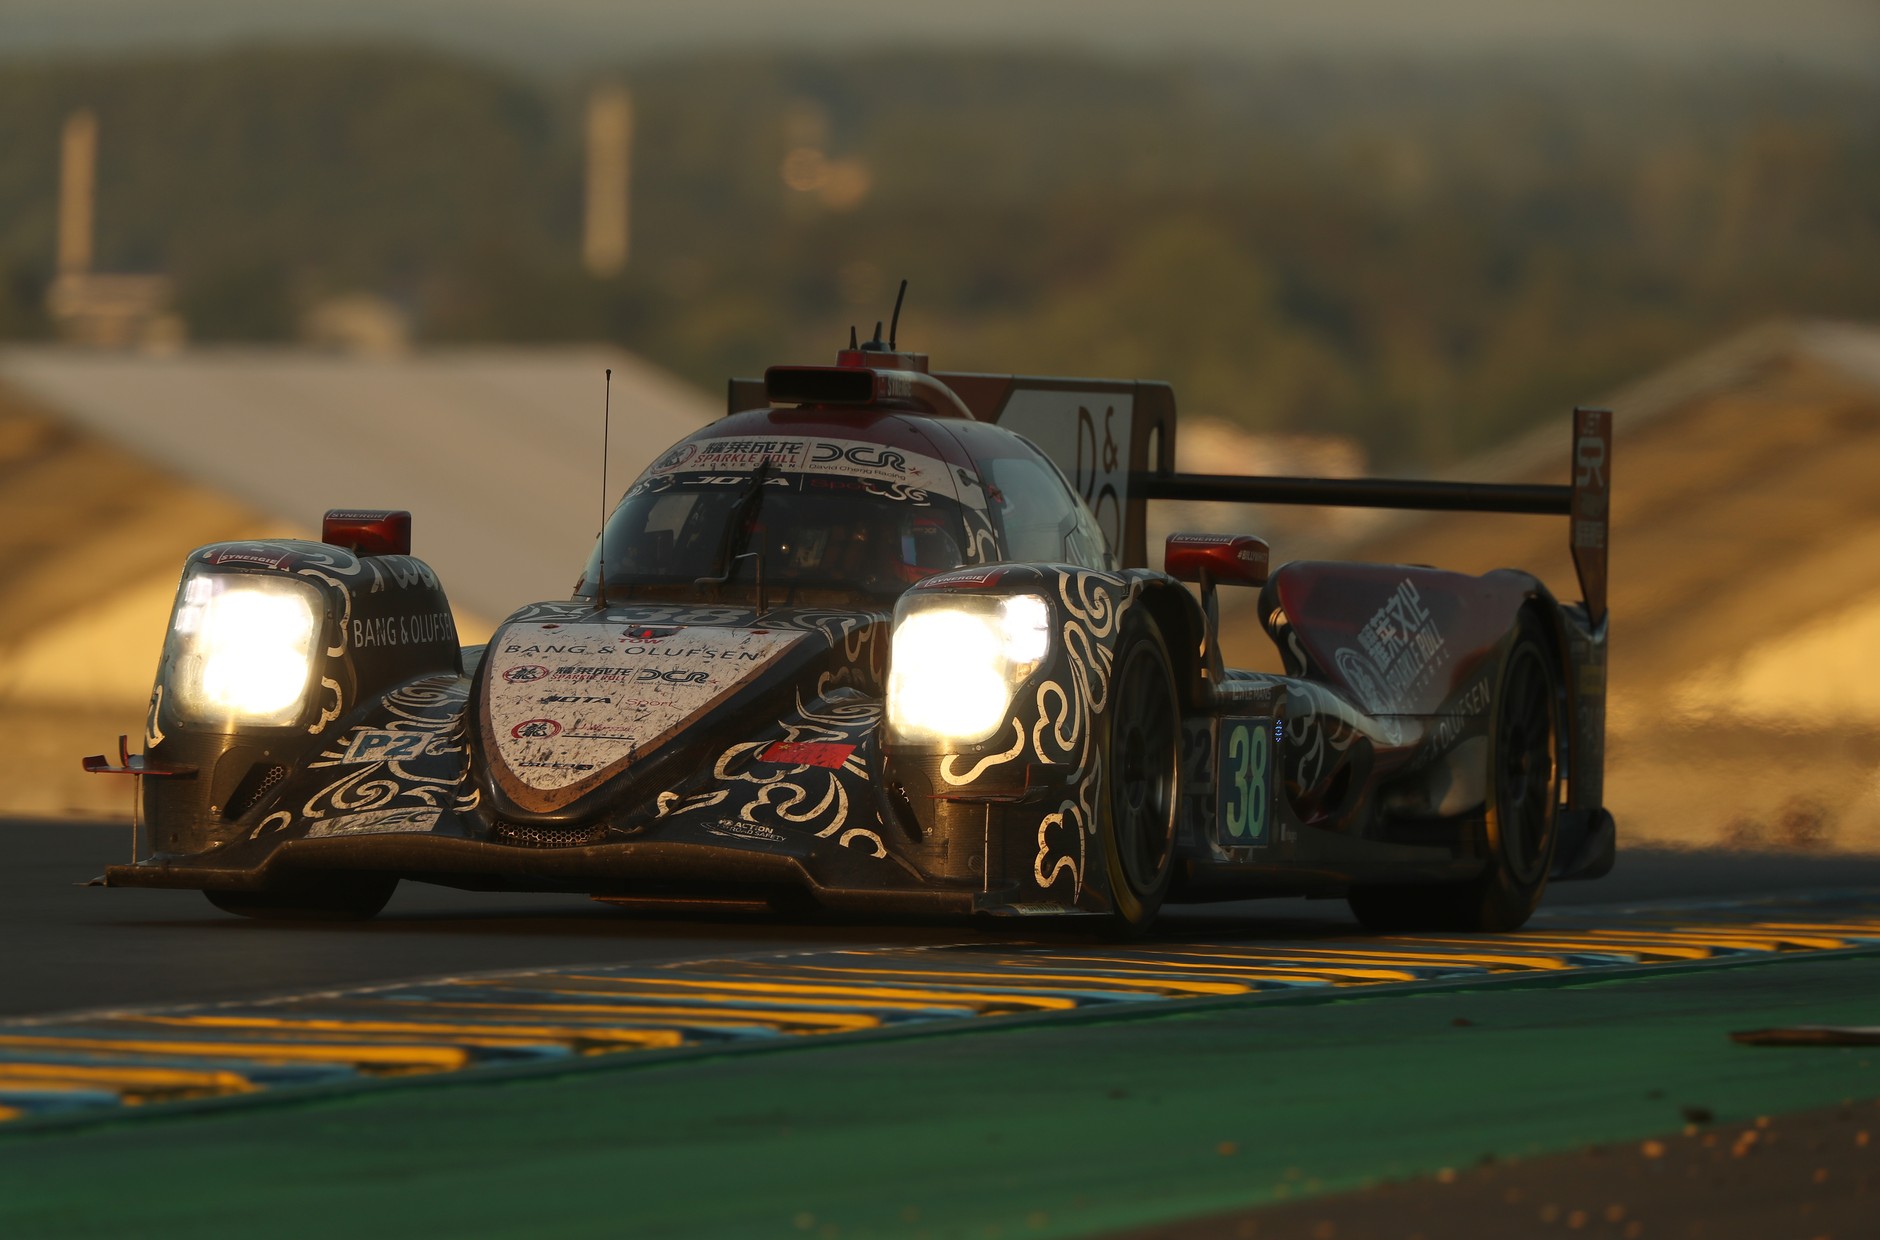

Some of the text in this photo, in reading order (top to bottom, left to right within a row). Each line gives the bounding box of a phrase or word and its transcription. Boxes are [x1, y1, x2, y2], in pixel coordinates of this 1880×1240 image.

[694, 453, 756, 464] SPARKLE
[839, 465, 873, 475] Cheng
[874, 469, 906, 480] Racing
[682, 475, 790, 486] JOA
[221, 554, 278, 564] SYNERGIE
[929, 575, 985, 584] SYNERGIE
[606, 606, 752, 623] 38
[353, 616, 397, 648] BANG
[400, 615, 409, 644] &
[504, 645, 761, 661] BANG & OLUFSEN
[625, 698, 673, 707] Sport
[1440, 677, 1491, 750] OLUFSEN
[352, 734, 421, 758] P2
[1226, 724, 1267, 838] 38
[734, 821, 775, 834] ACTION
